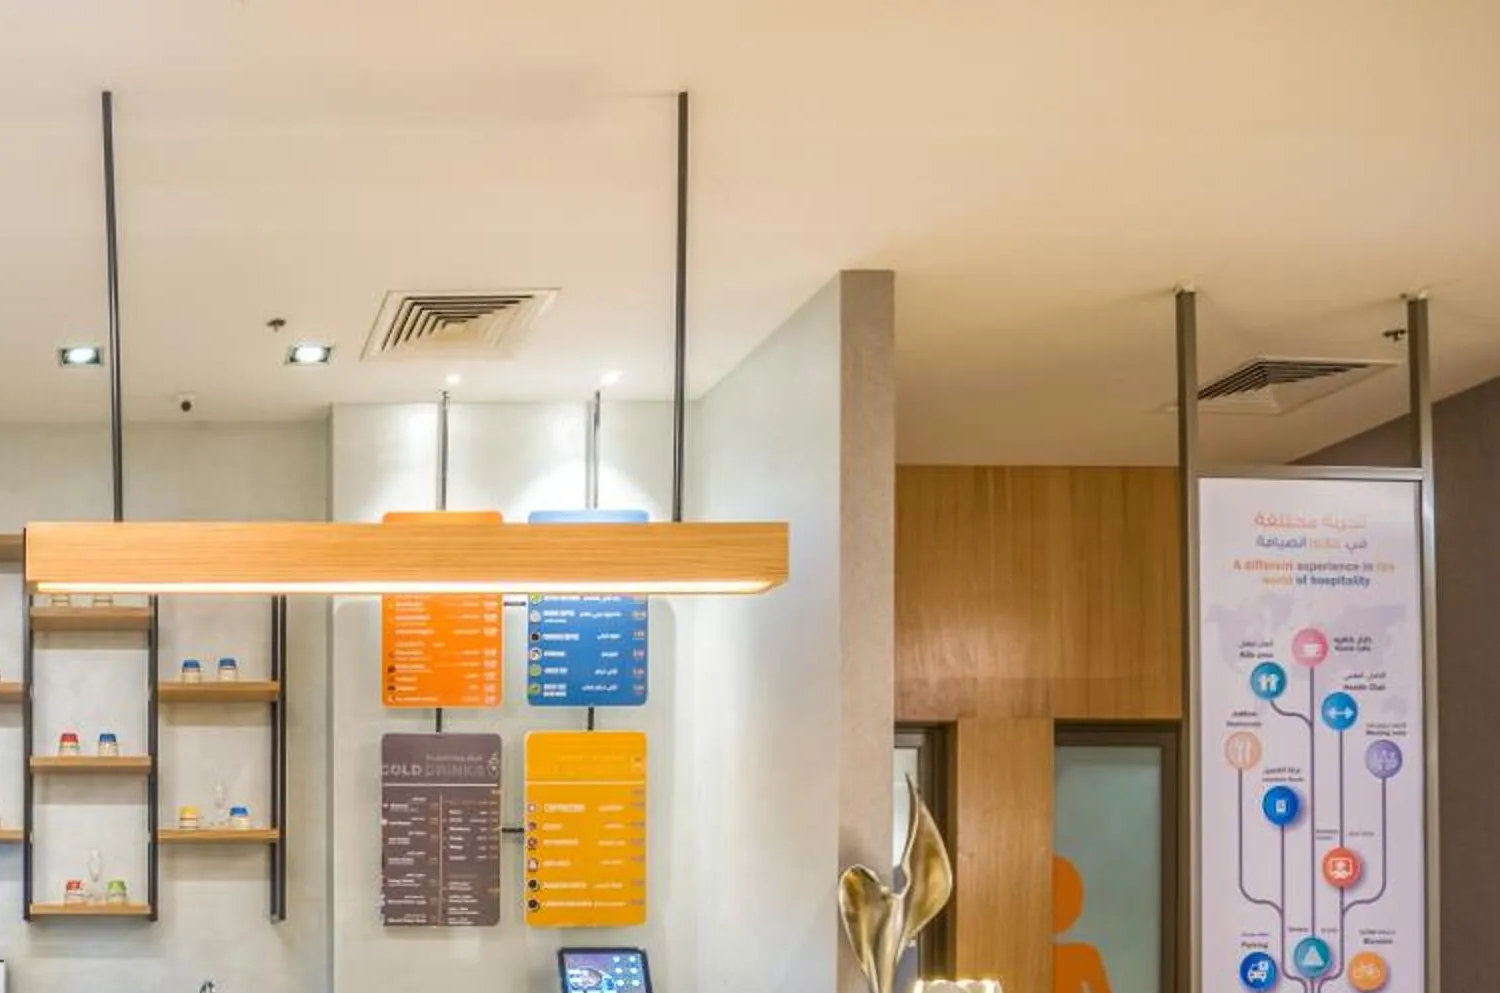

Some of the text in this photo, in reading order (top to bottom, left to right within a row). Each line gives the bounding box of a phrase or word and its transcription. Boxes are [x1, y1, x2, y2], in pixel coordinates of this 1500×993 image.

[1233, 560, 1242, 570] A
[1296, 560, 1360, 573] experience
[1296, 575, 1307, 586] of
[1310, 575, 1371, 588] hospitality
[380, 764, 422, 776] COLD
